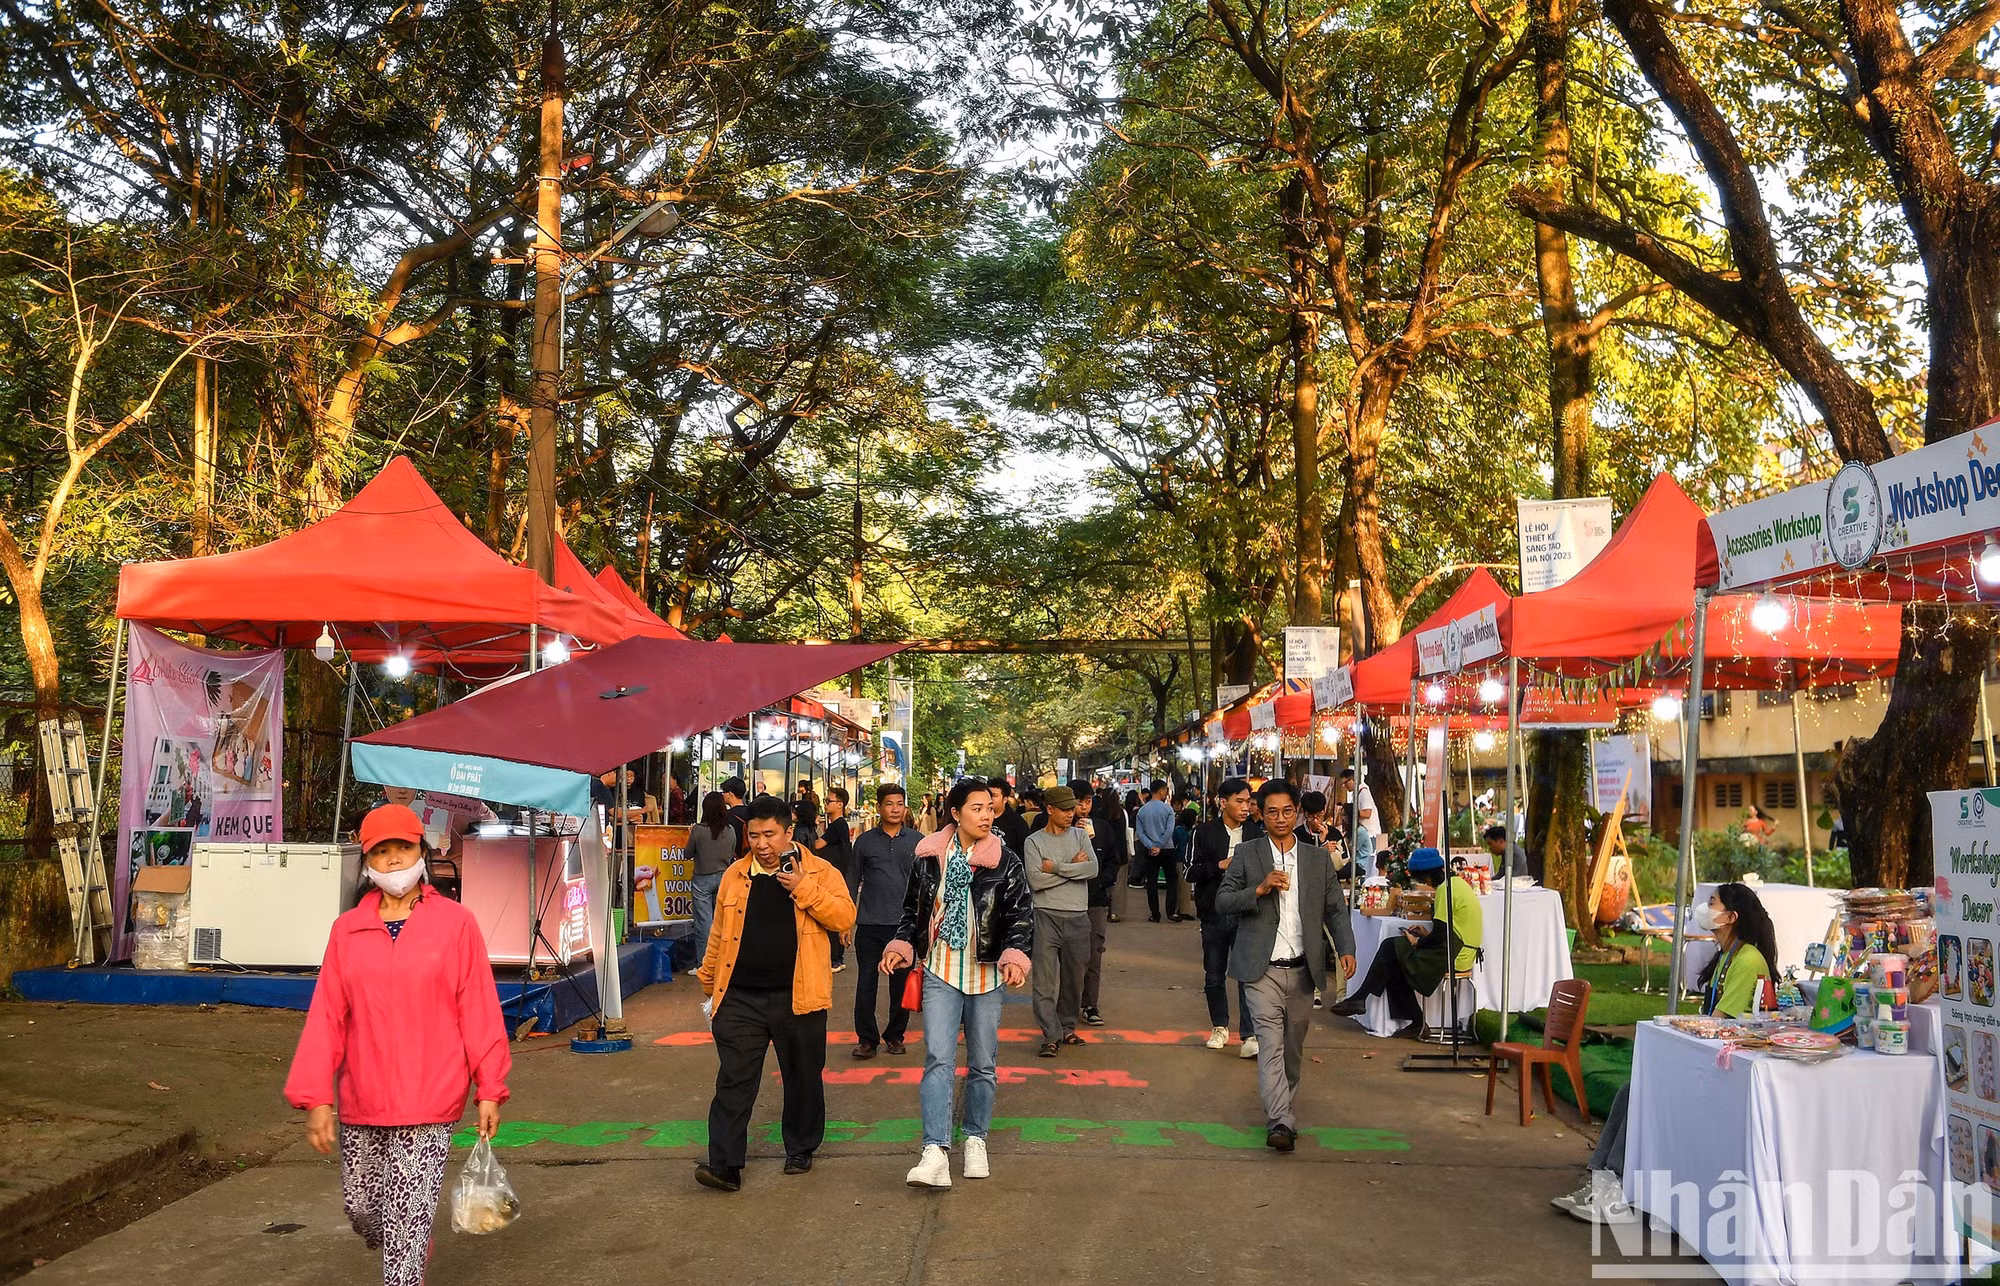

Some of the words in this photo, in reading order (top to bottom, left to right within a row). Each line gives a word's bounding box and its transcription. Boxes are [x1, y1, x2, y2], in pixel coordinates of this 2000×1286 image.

[1888, 471, 1969, 522] Workshop
[1726, 525, 1773, 558] Accessories
[1772, 511, 1822, 545] Workshop
[1838, 521, 1868, 536] CREATIVE
[1553, 552, 1572, 560] 2023
[215, 815, 239, 836] KEM
[242, 814, 273, 838] QUE
[661, 845, 693, 861] BÁN
[672, 864, 684, 876] 10
[664, 880, 692, 893] WON
[664, 895, 693, 916] 30k
[1962, 894, 1993, 923] Decor
